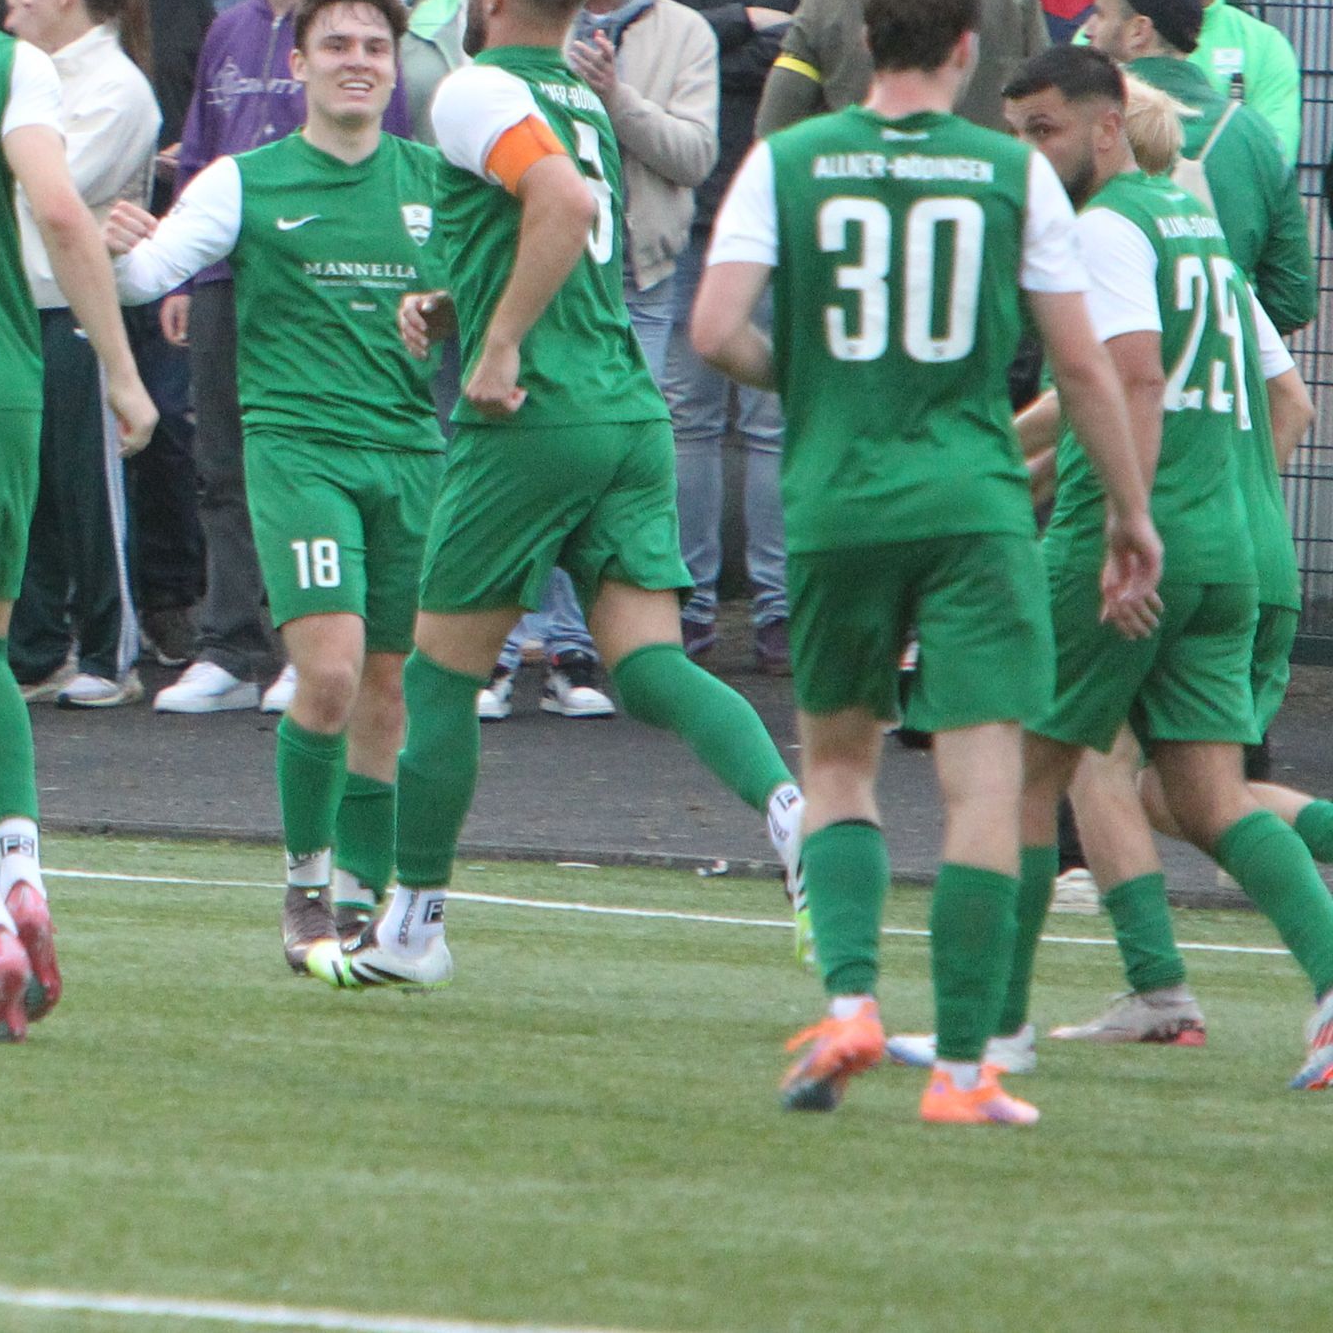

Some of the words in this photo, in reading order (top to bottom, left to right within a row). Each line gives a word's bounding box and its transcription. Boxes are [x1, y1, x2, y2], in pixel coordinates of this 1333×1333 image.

[303, 261, 419, 280] MANNELLA
[817, 196, 986, 363] 30
[290, 538, 342, 590] 18
